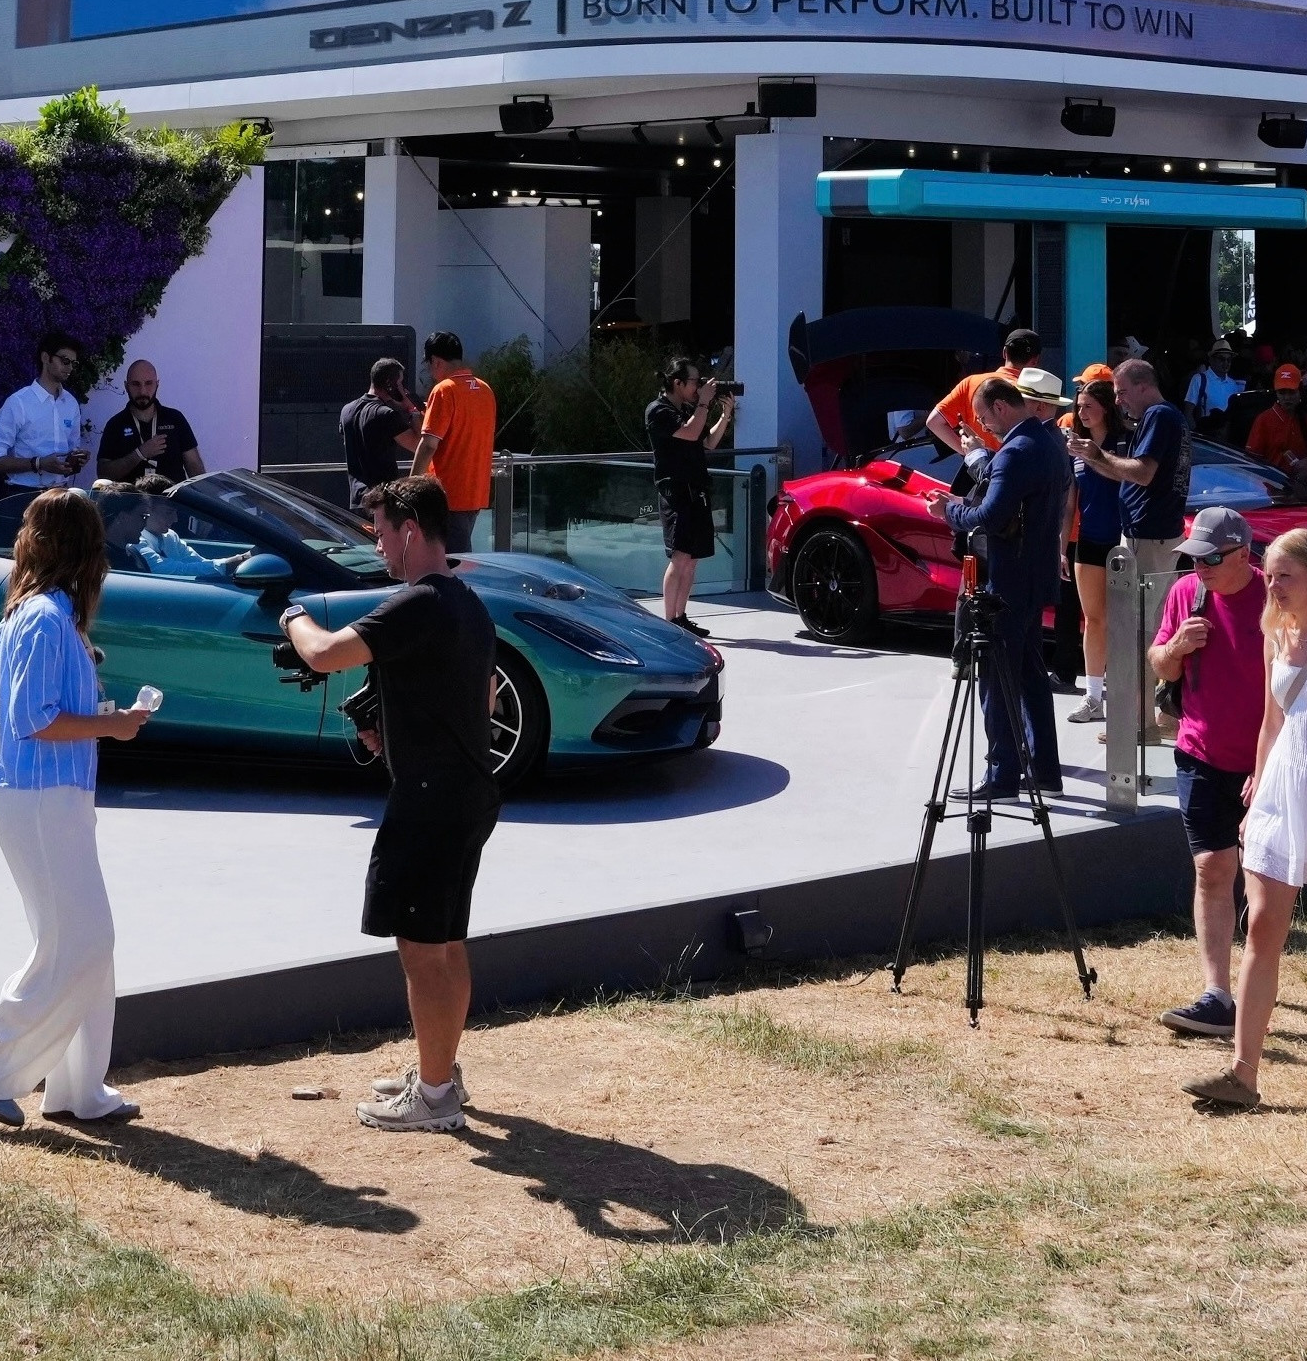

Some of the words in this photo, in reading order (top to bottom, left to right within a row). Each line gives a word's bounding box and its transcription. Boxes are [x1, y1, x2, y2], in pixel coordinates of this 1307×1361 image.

[309, 9, 494, 50] DENZA
[502, 0, 532, 28] Z
[1084, 1, 1126, 31] TO
[1134, 6, 1194, 38] WIN
[1100, 196, 1122, 205] BYD
